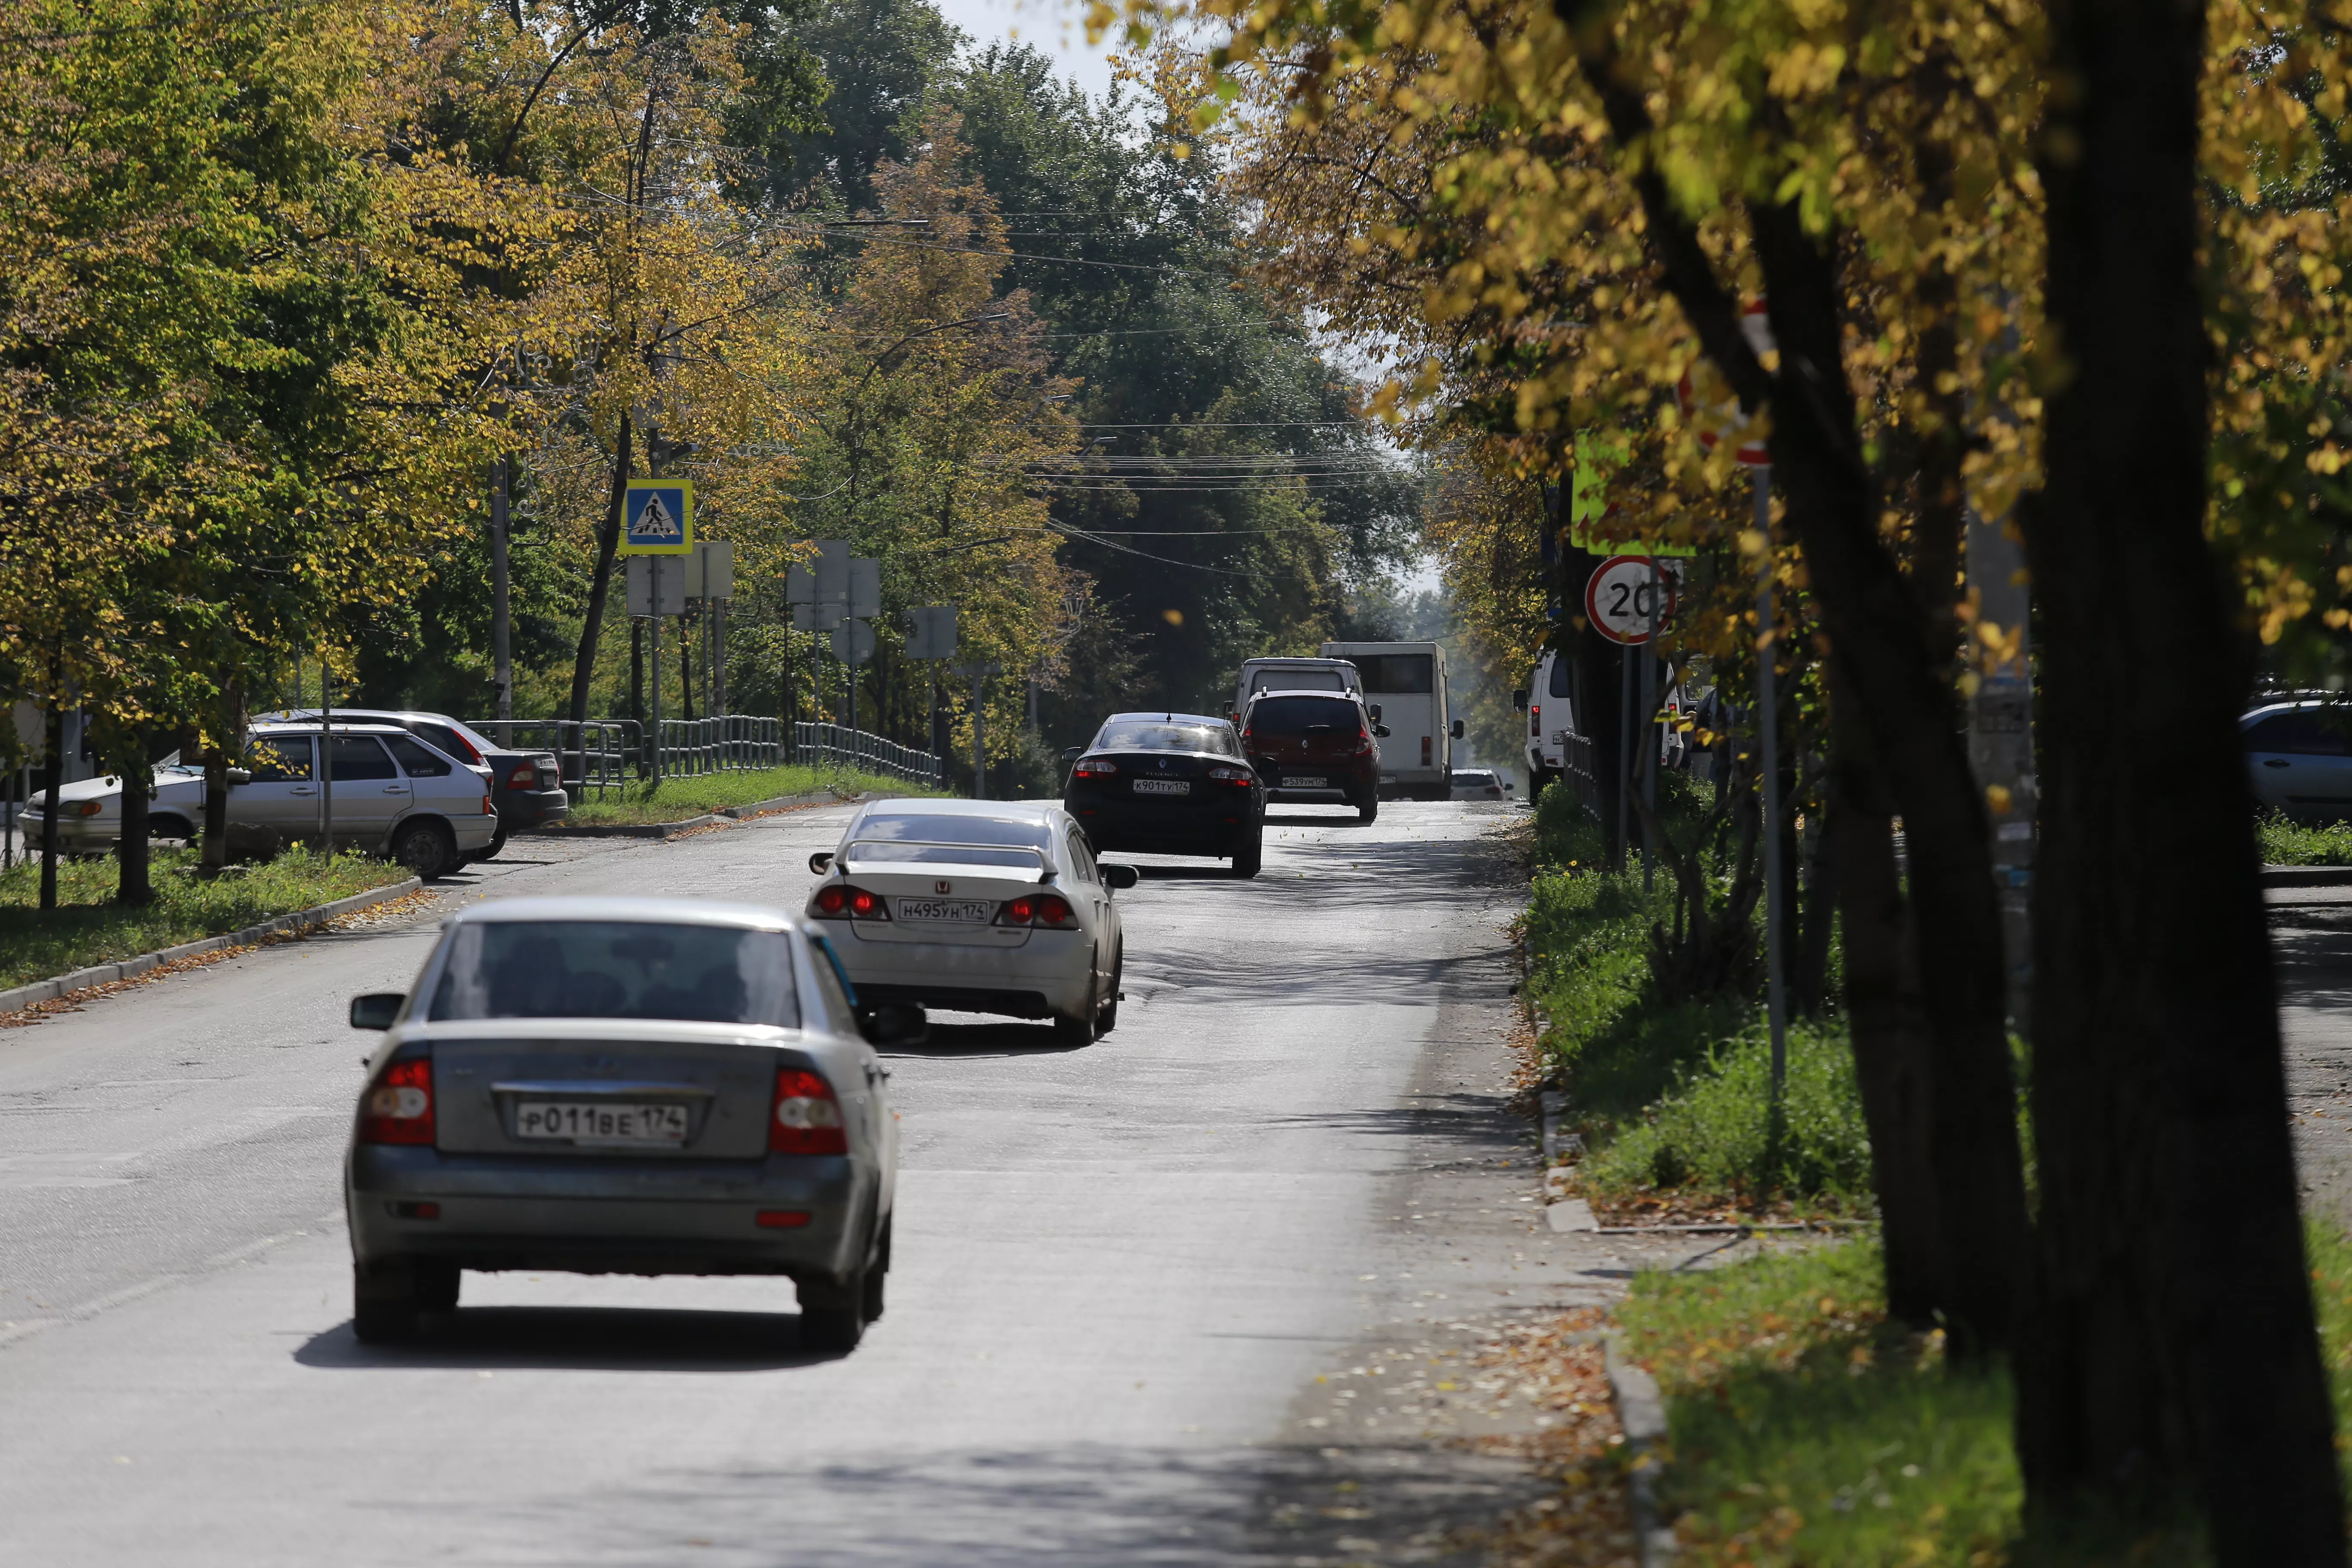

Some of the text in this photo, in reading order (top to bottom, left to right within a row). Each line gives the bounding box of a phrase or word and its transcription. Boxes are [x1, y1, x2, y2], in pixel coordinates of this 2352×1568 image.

[1609, 582, 1655, 617] 20
[1136, 781, 1172, 791] К901ТУ
[904, 903, 984, 919] Н495УН 174
[526, 1107, 682, 1135] Р011ВЕ 174
